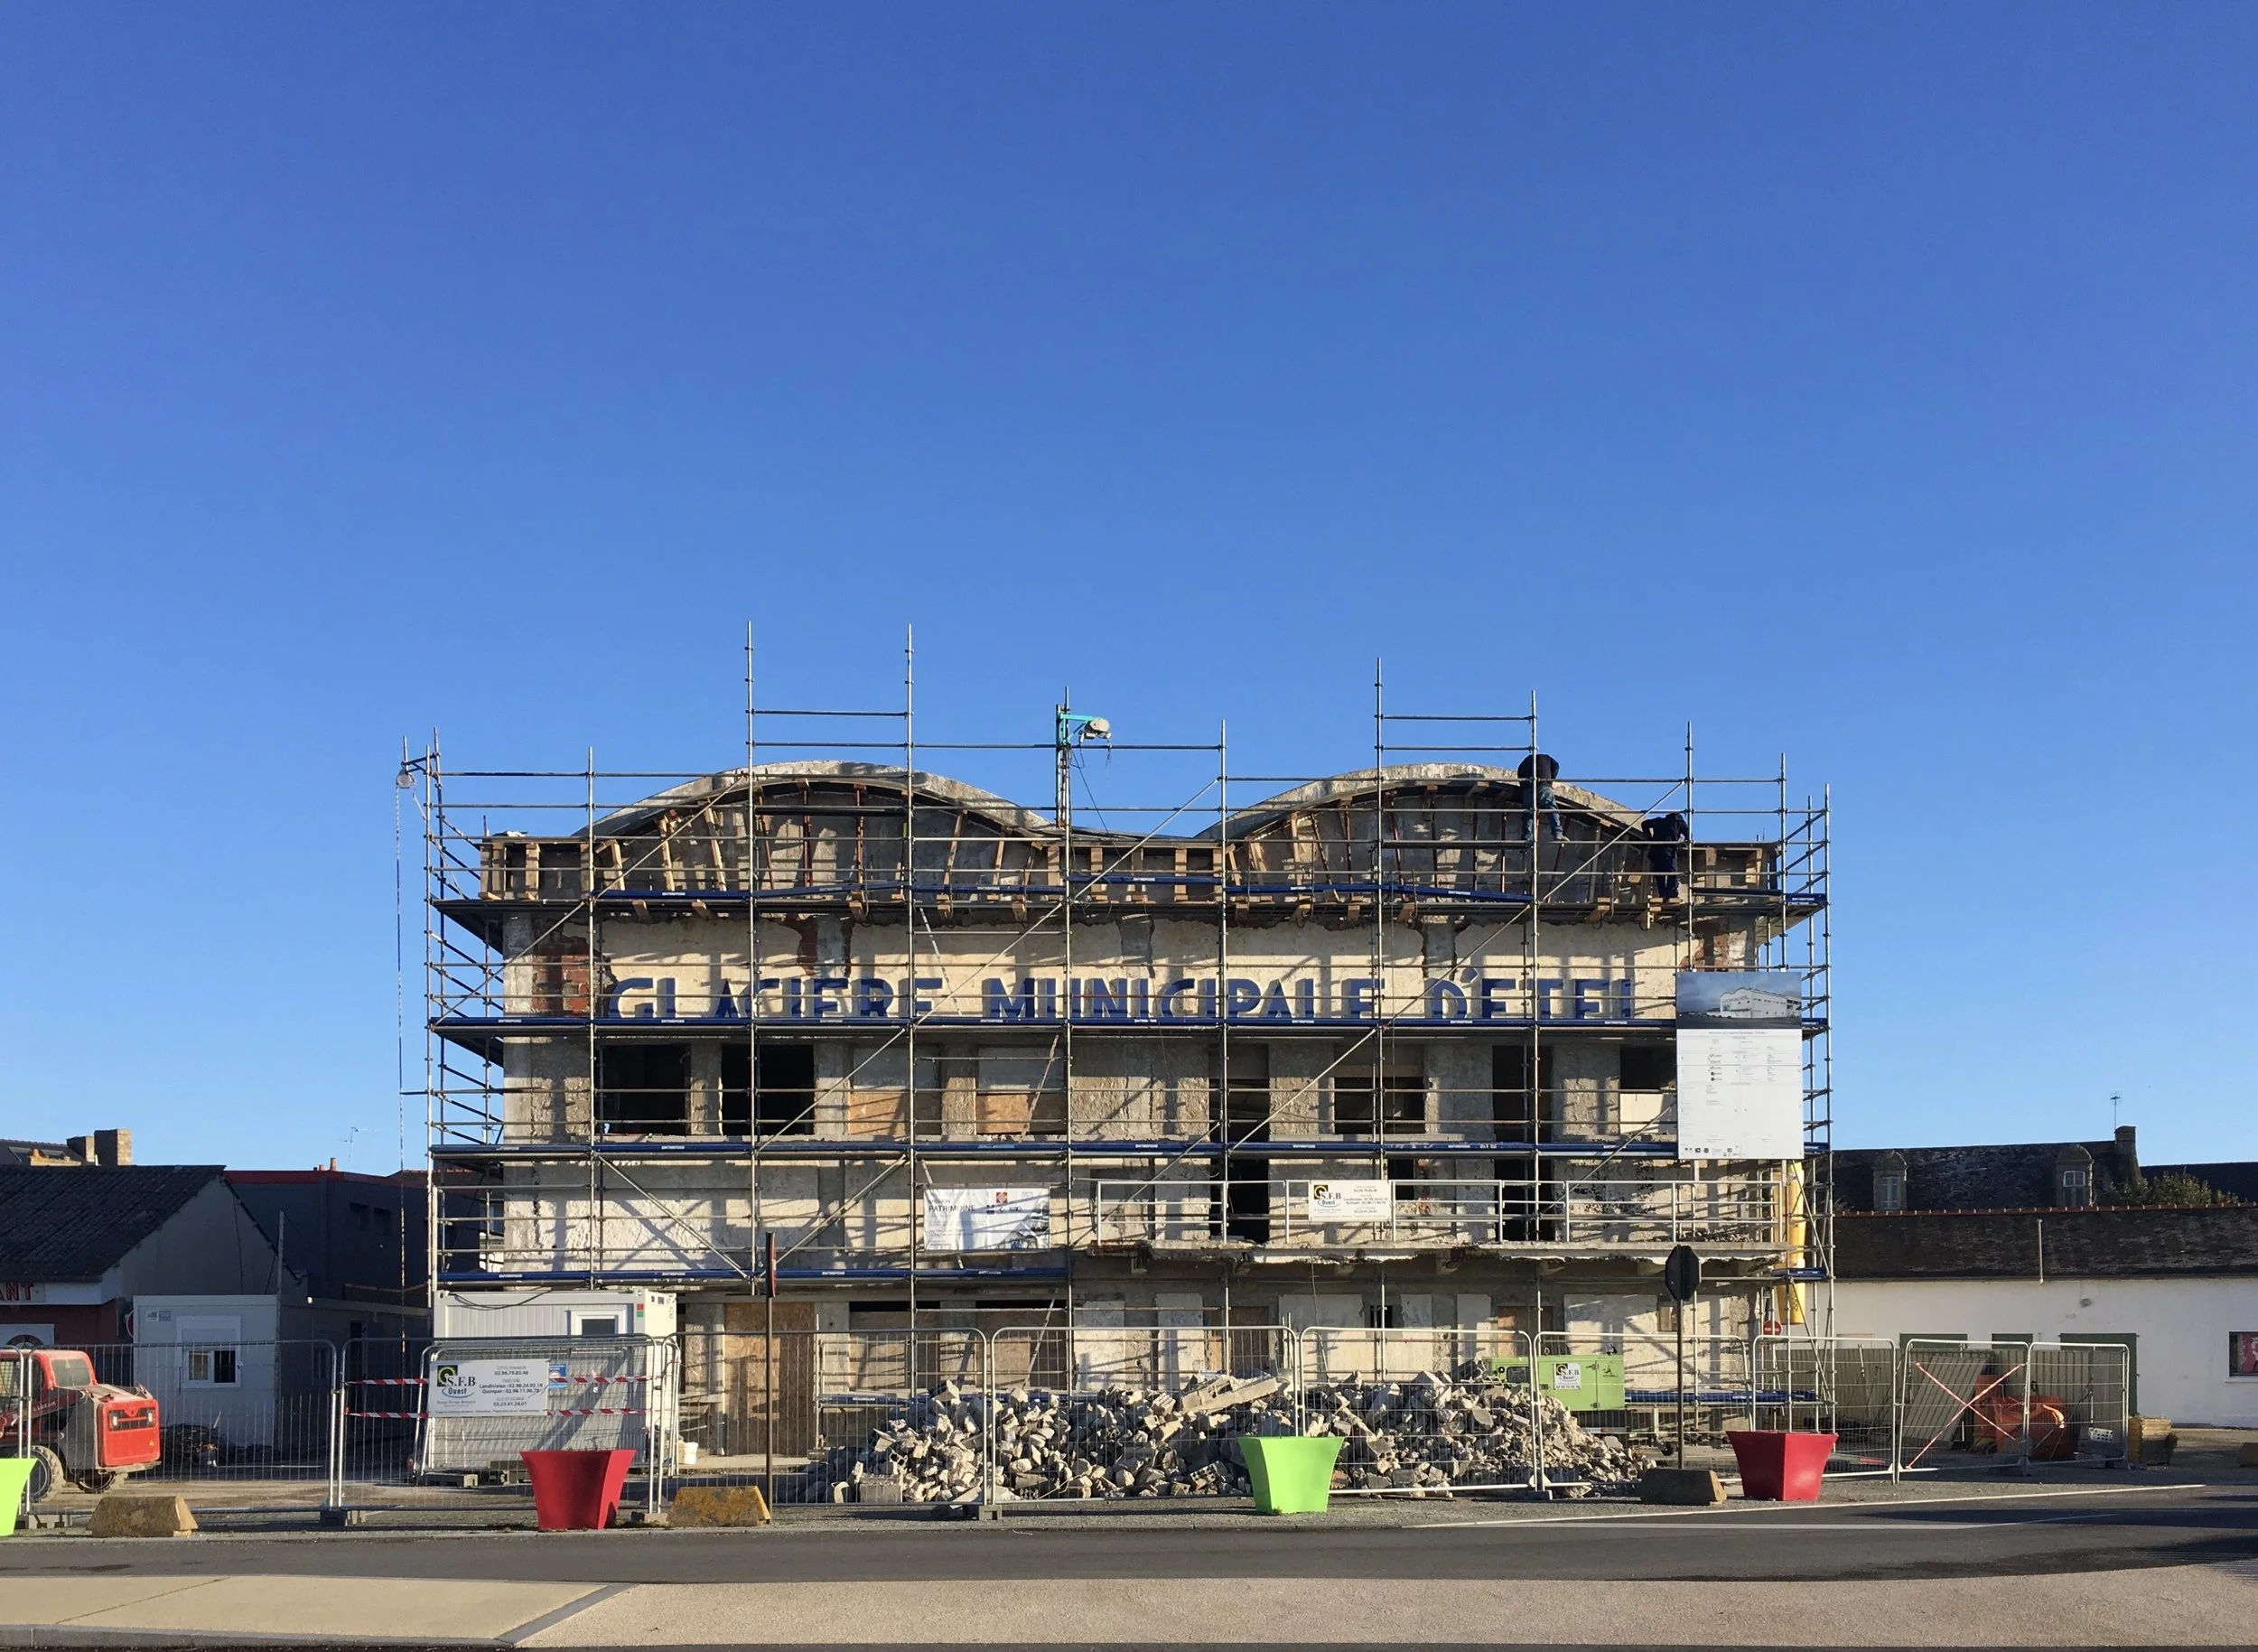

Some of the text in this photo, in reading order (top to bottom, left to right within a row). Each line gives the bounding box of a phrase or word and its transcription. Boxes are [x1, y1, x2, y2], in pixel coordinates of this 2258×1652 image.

[928, 1204, 975, 1212] PATRIMOINE
[447, 1376, 476, 1387] S.F.B
[448, 1386, 467, 1395] Ouest
